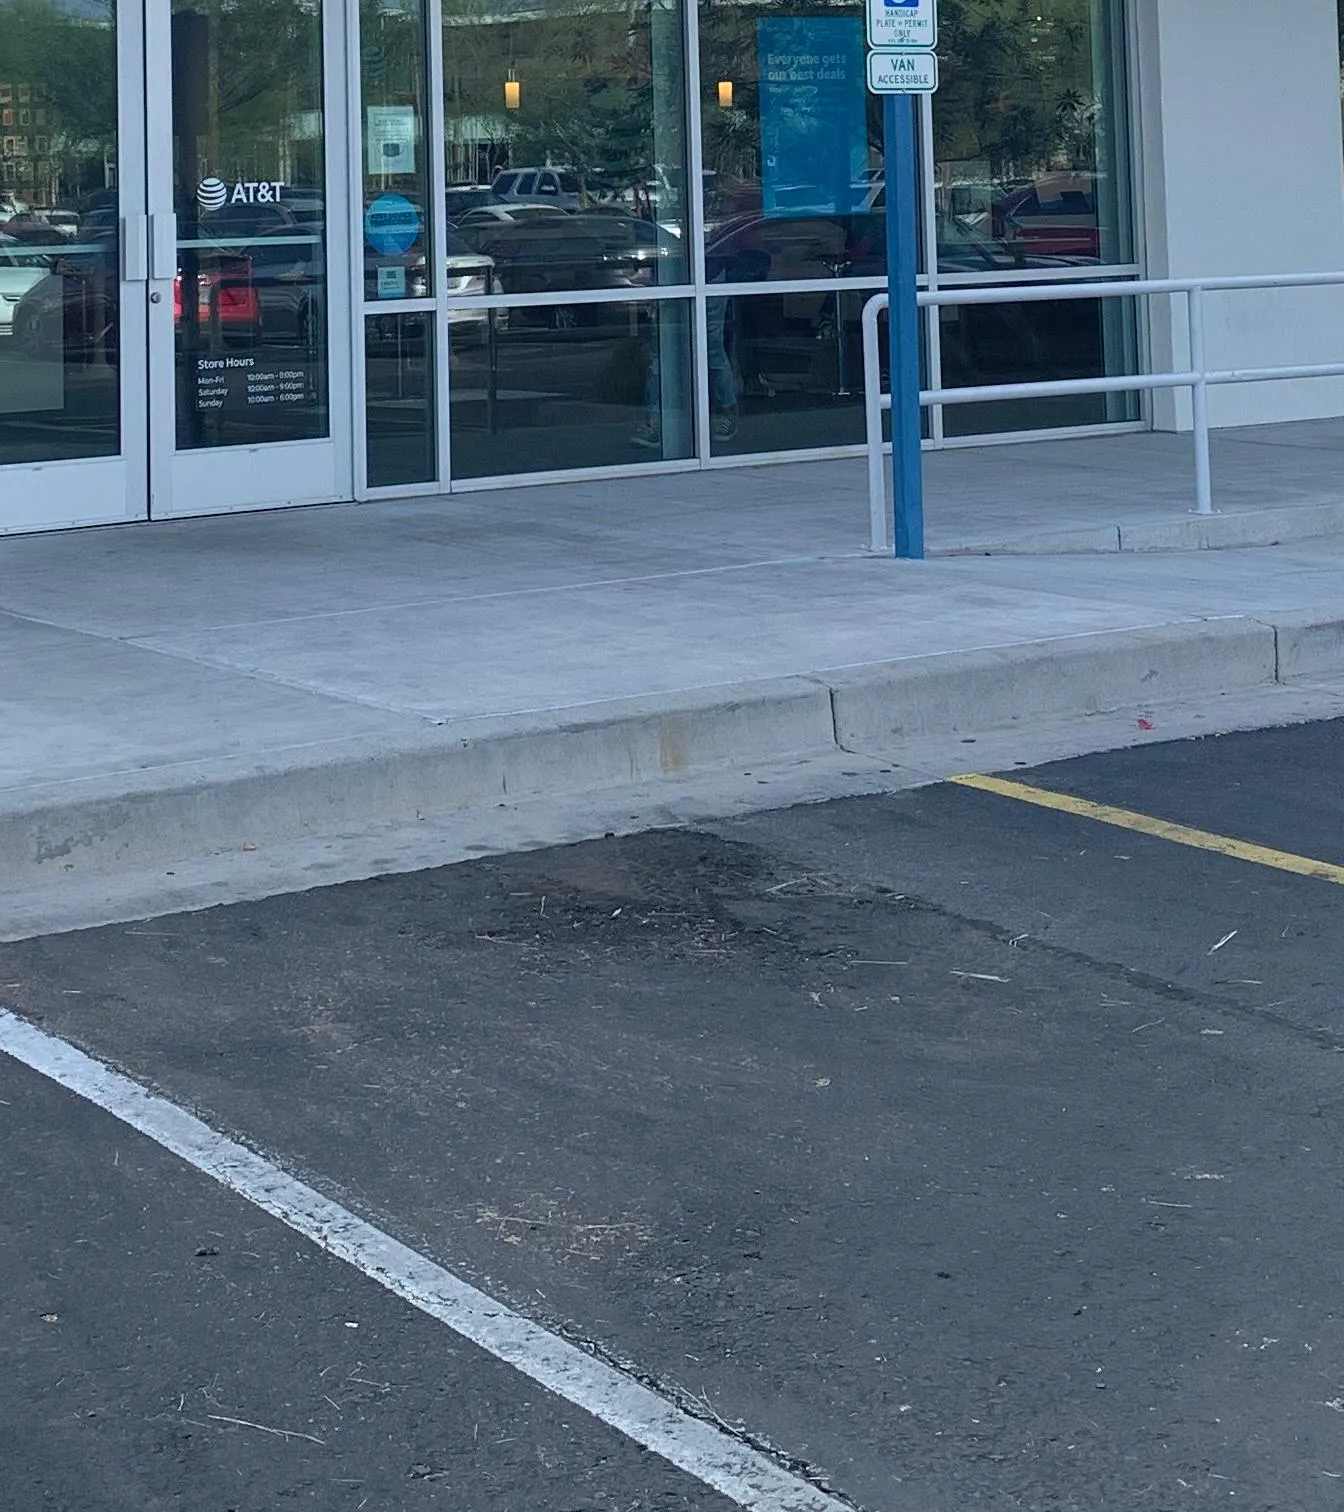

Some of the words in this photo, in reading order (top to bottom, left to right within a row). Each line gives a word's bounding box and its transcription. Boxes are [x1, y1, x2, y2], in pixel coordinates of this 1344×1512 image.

[885, 9, 919, 18] HANDICAP
[876, 19, 896, 28] PLATE
[904, 19, 928, 28] PERMIT
[767, 53, 820, 69] Everyone
[822, 53, 846, 67] gets
[891, 58, 915, 71] VAN
[789, 68, 814, 81] best
[817, 68, 846, 80] deals
[877, 74, 929, 84] ACCESSIBLE
[231, 182, 284, 203] AT&T
[197, 359, 224, 369] Store
[226, 358, 254, 368] Hours
[197, 376, 224, 384] Mon-Fri
[198, 387, 228, 397] Saturday
[198, 399, 223, 408] Sunday
